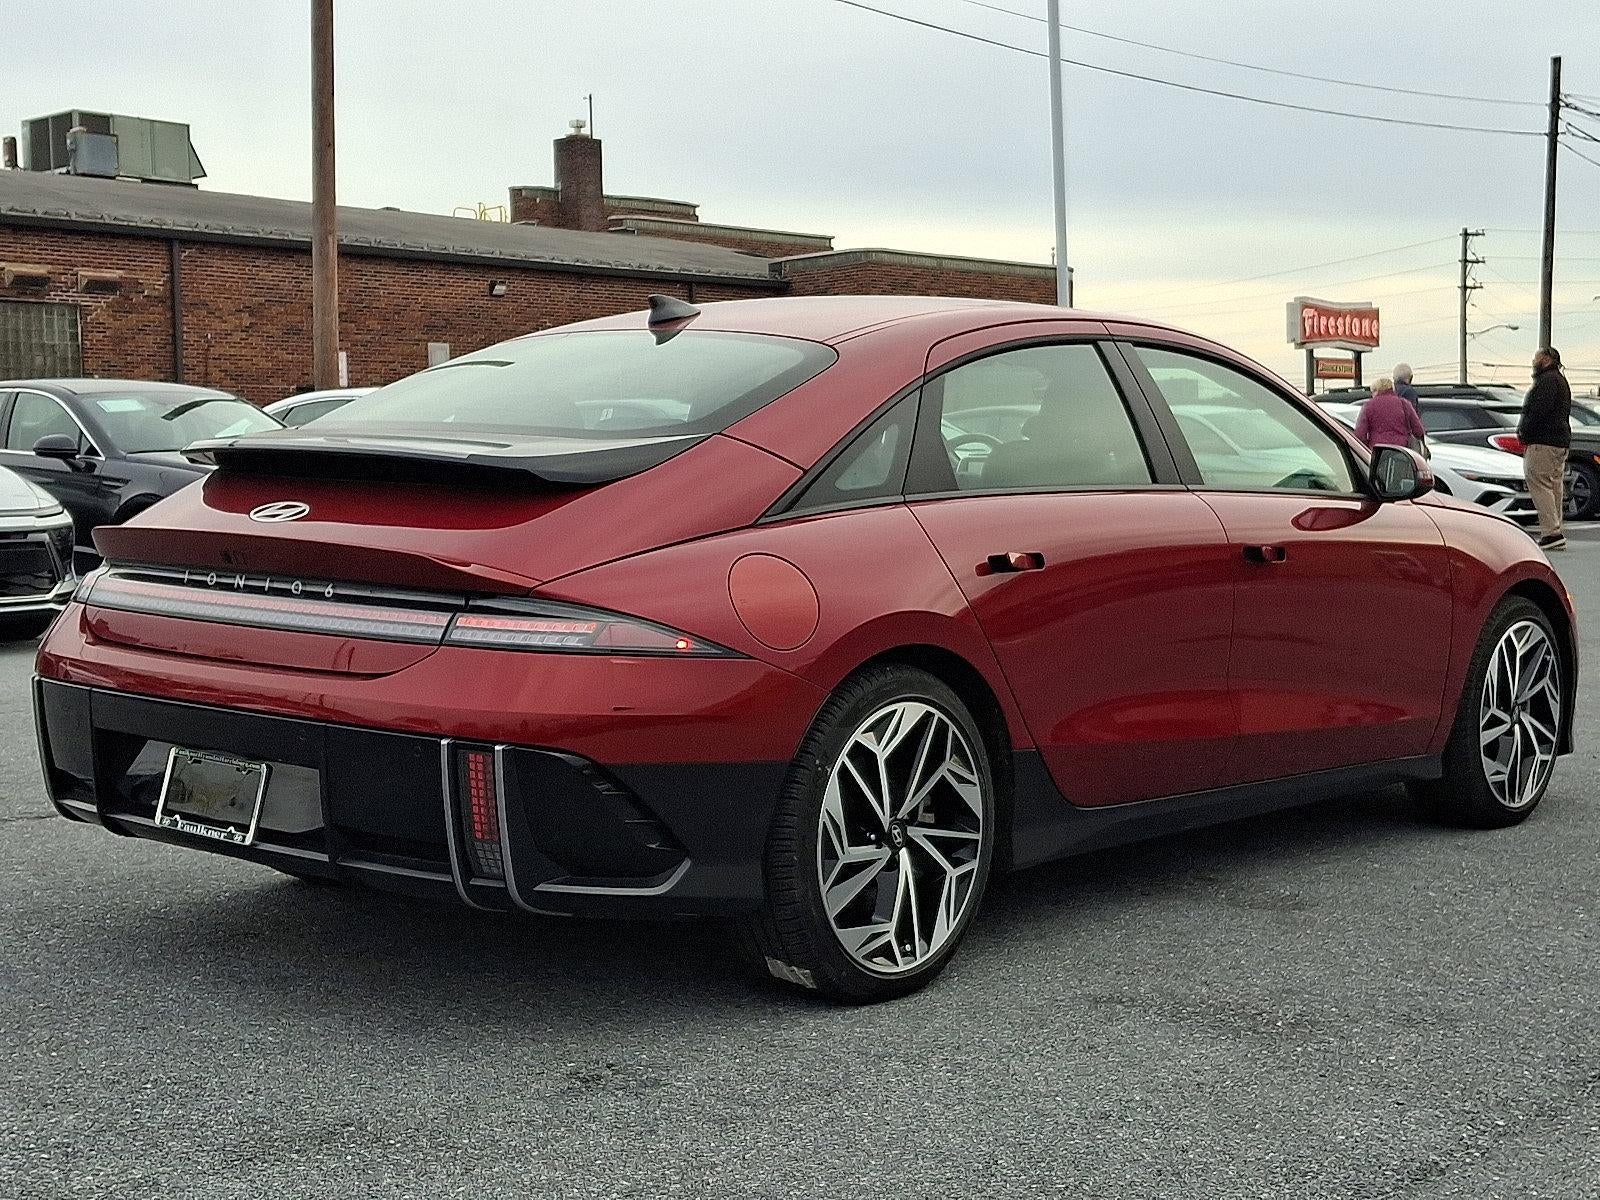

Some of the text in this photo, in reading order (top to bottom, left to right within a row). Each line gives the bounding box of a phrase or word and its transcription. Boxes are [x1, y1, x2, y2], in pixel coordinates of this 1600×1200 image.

[1302, 308, 1378, 338] Firestone
[184, 569, 334, 598] IONIQ 6
[177, 820, 228, 840] Faulkner
